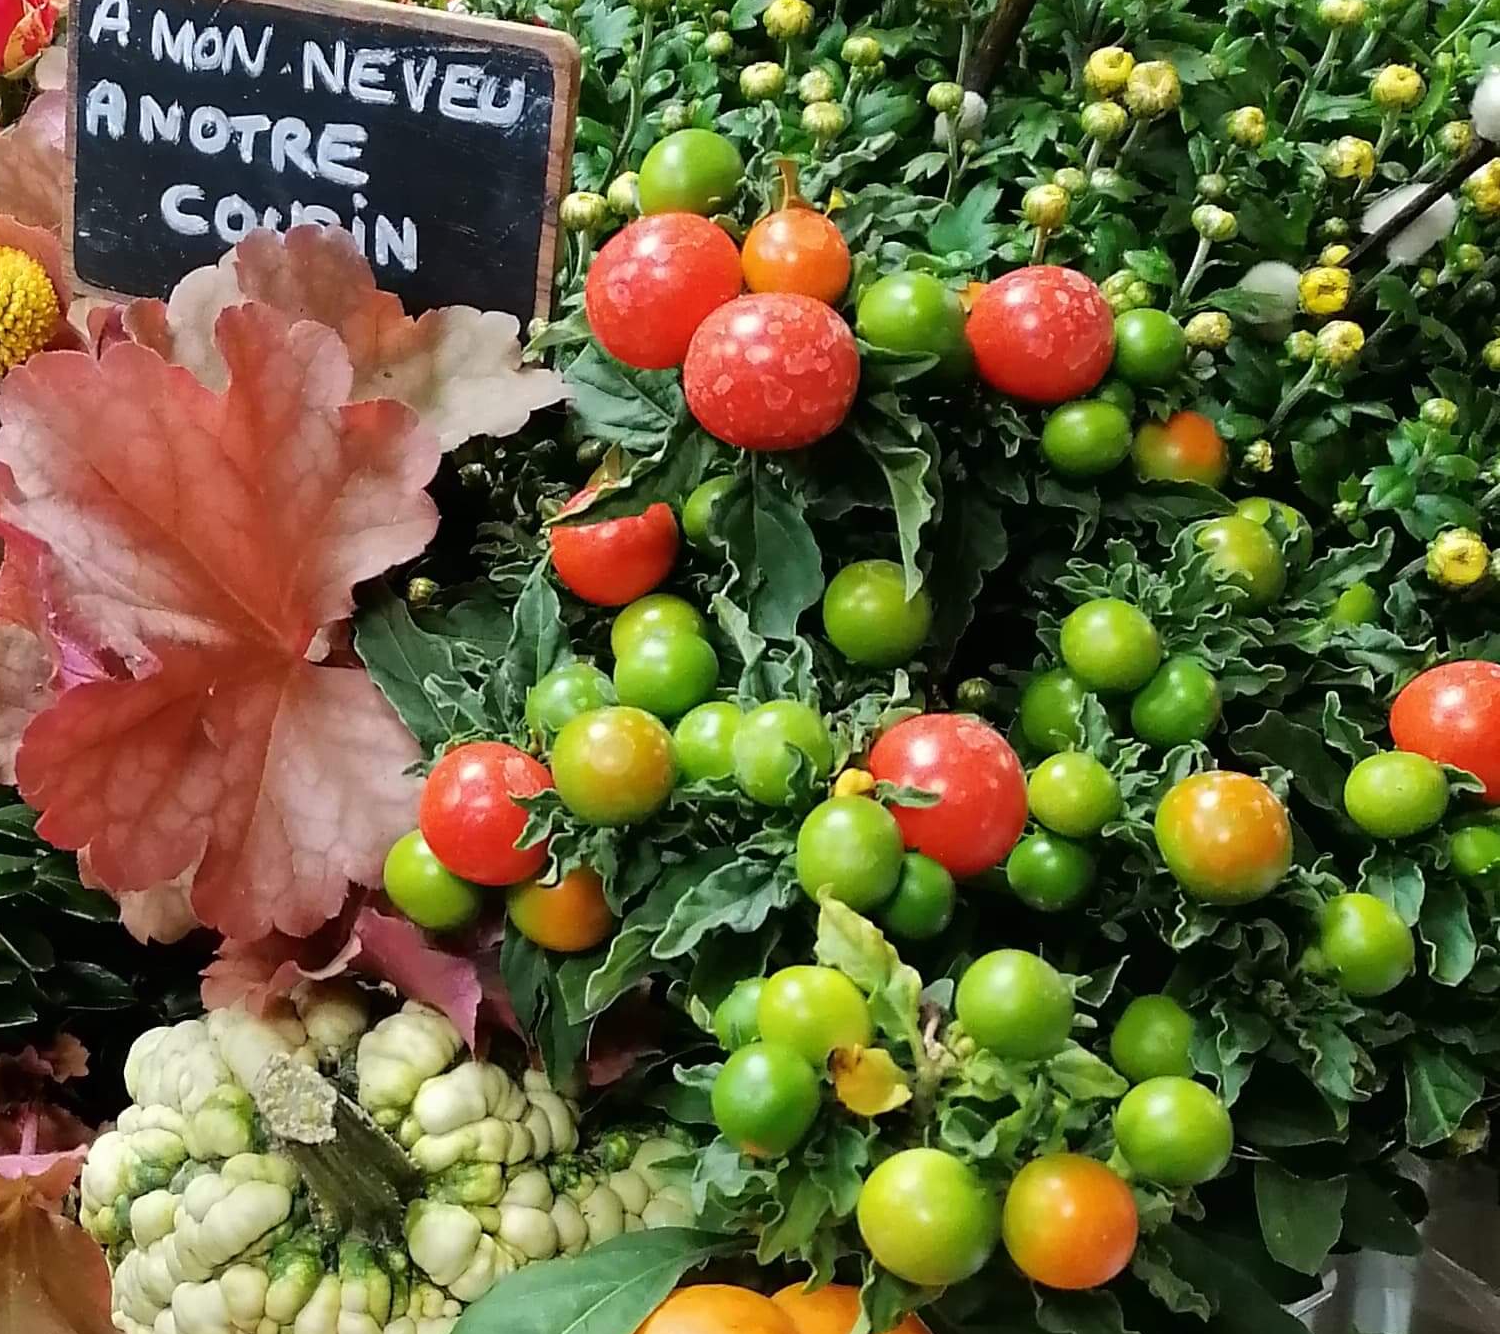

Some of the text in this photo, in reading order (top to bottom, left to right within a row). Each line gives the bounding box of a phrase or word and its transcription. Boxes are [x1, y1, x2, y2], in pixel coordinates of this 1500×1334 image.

[85, 78, 370, 185] A NOTRE
[303, 39, 527, 128] NEVEU
